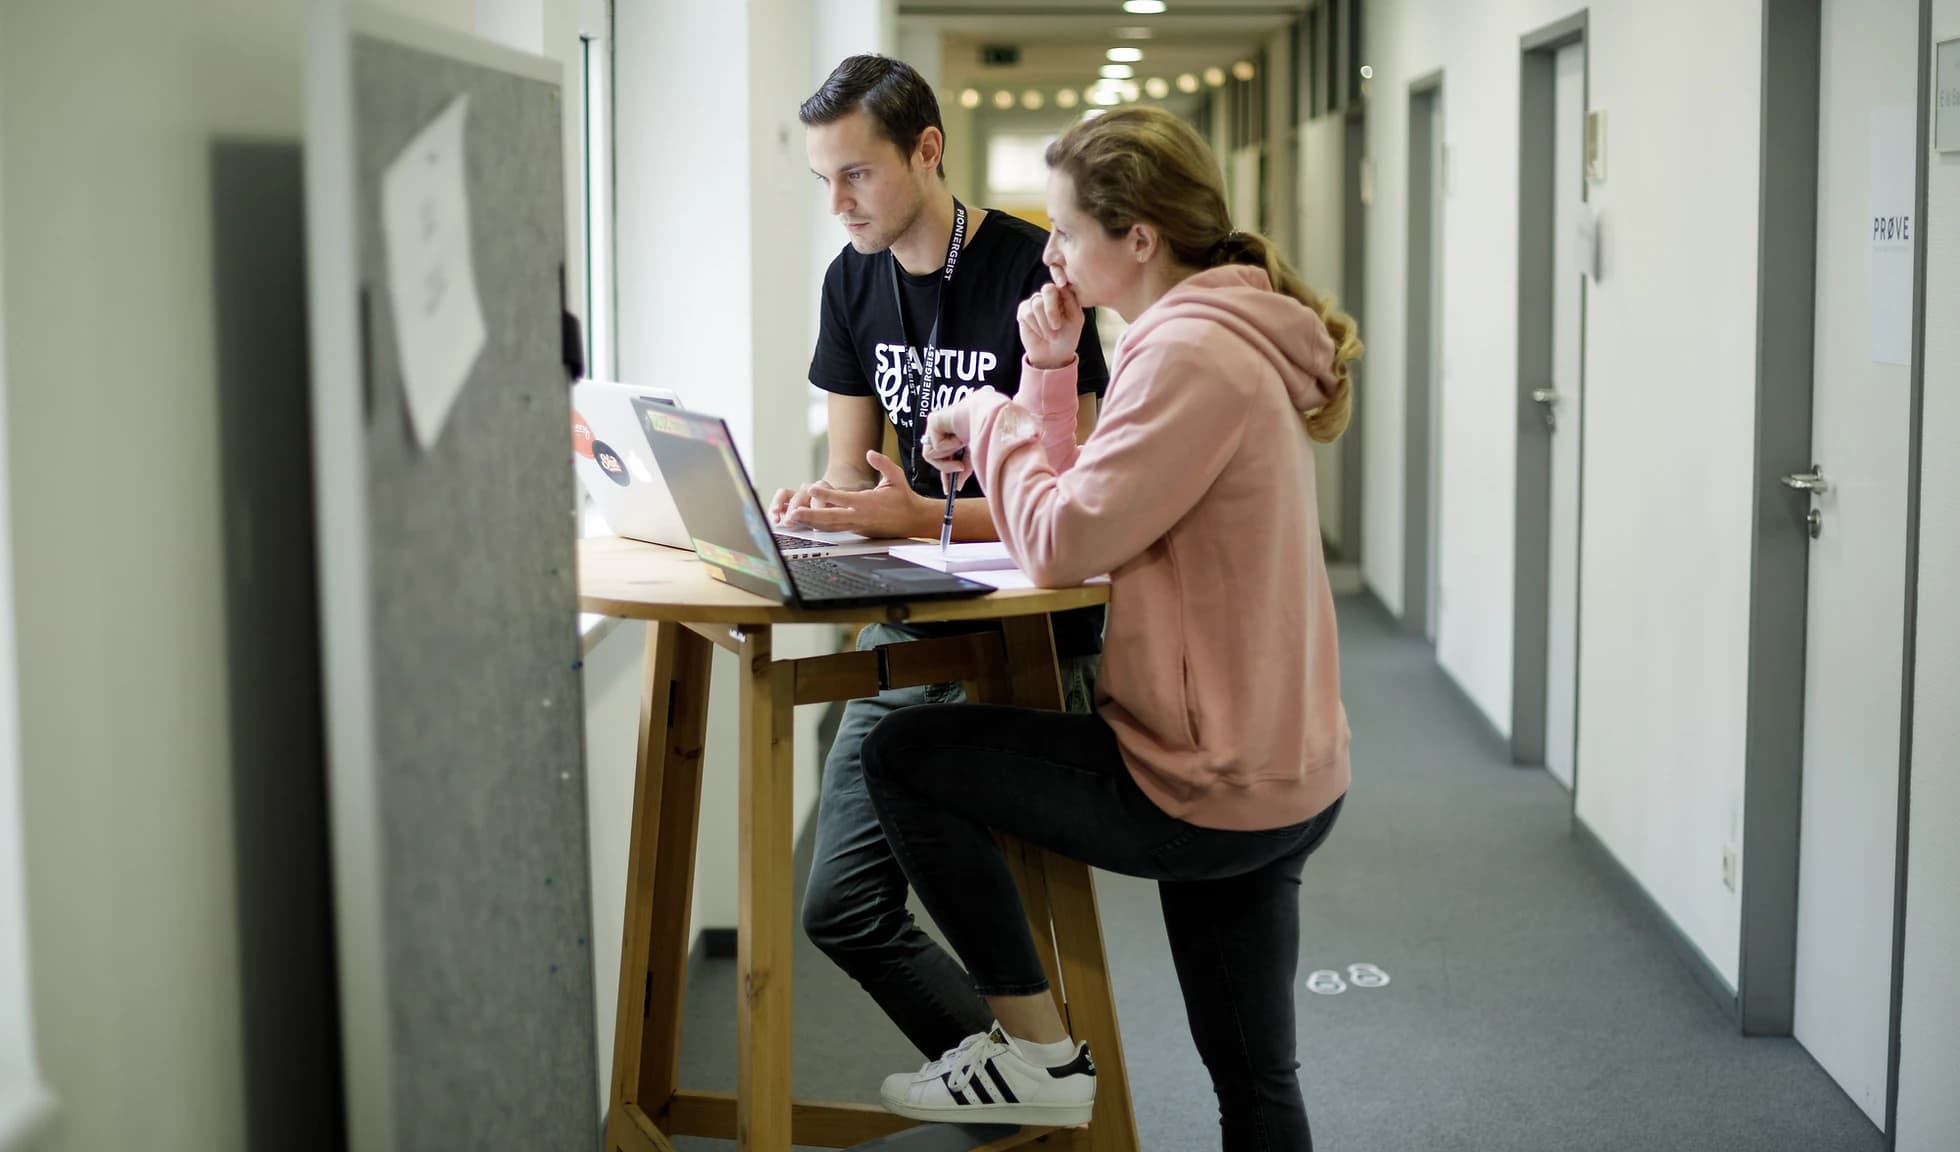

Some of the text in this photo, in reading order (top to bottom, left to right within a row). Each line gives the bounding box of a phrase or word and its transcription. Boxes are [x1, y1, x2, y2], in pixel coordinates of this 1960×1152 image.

[944, 208, 965, 280] PIONIERGEIST
[1873, 216, 1909, 240] PRØVE
[875, 343, 997, 381] STARTUP
[919, 344, 935, 418] PIONIERGEIST
